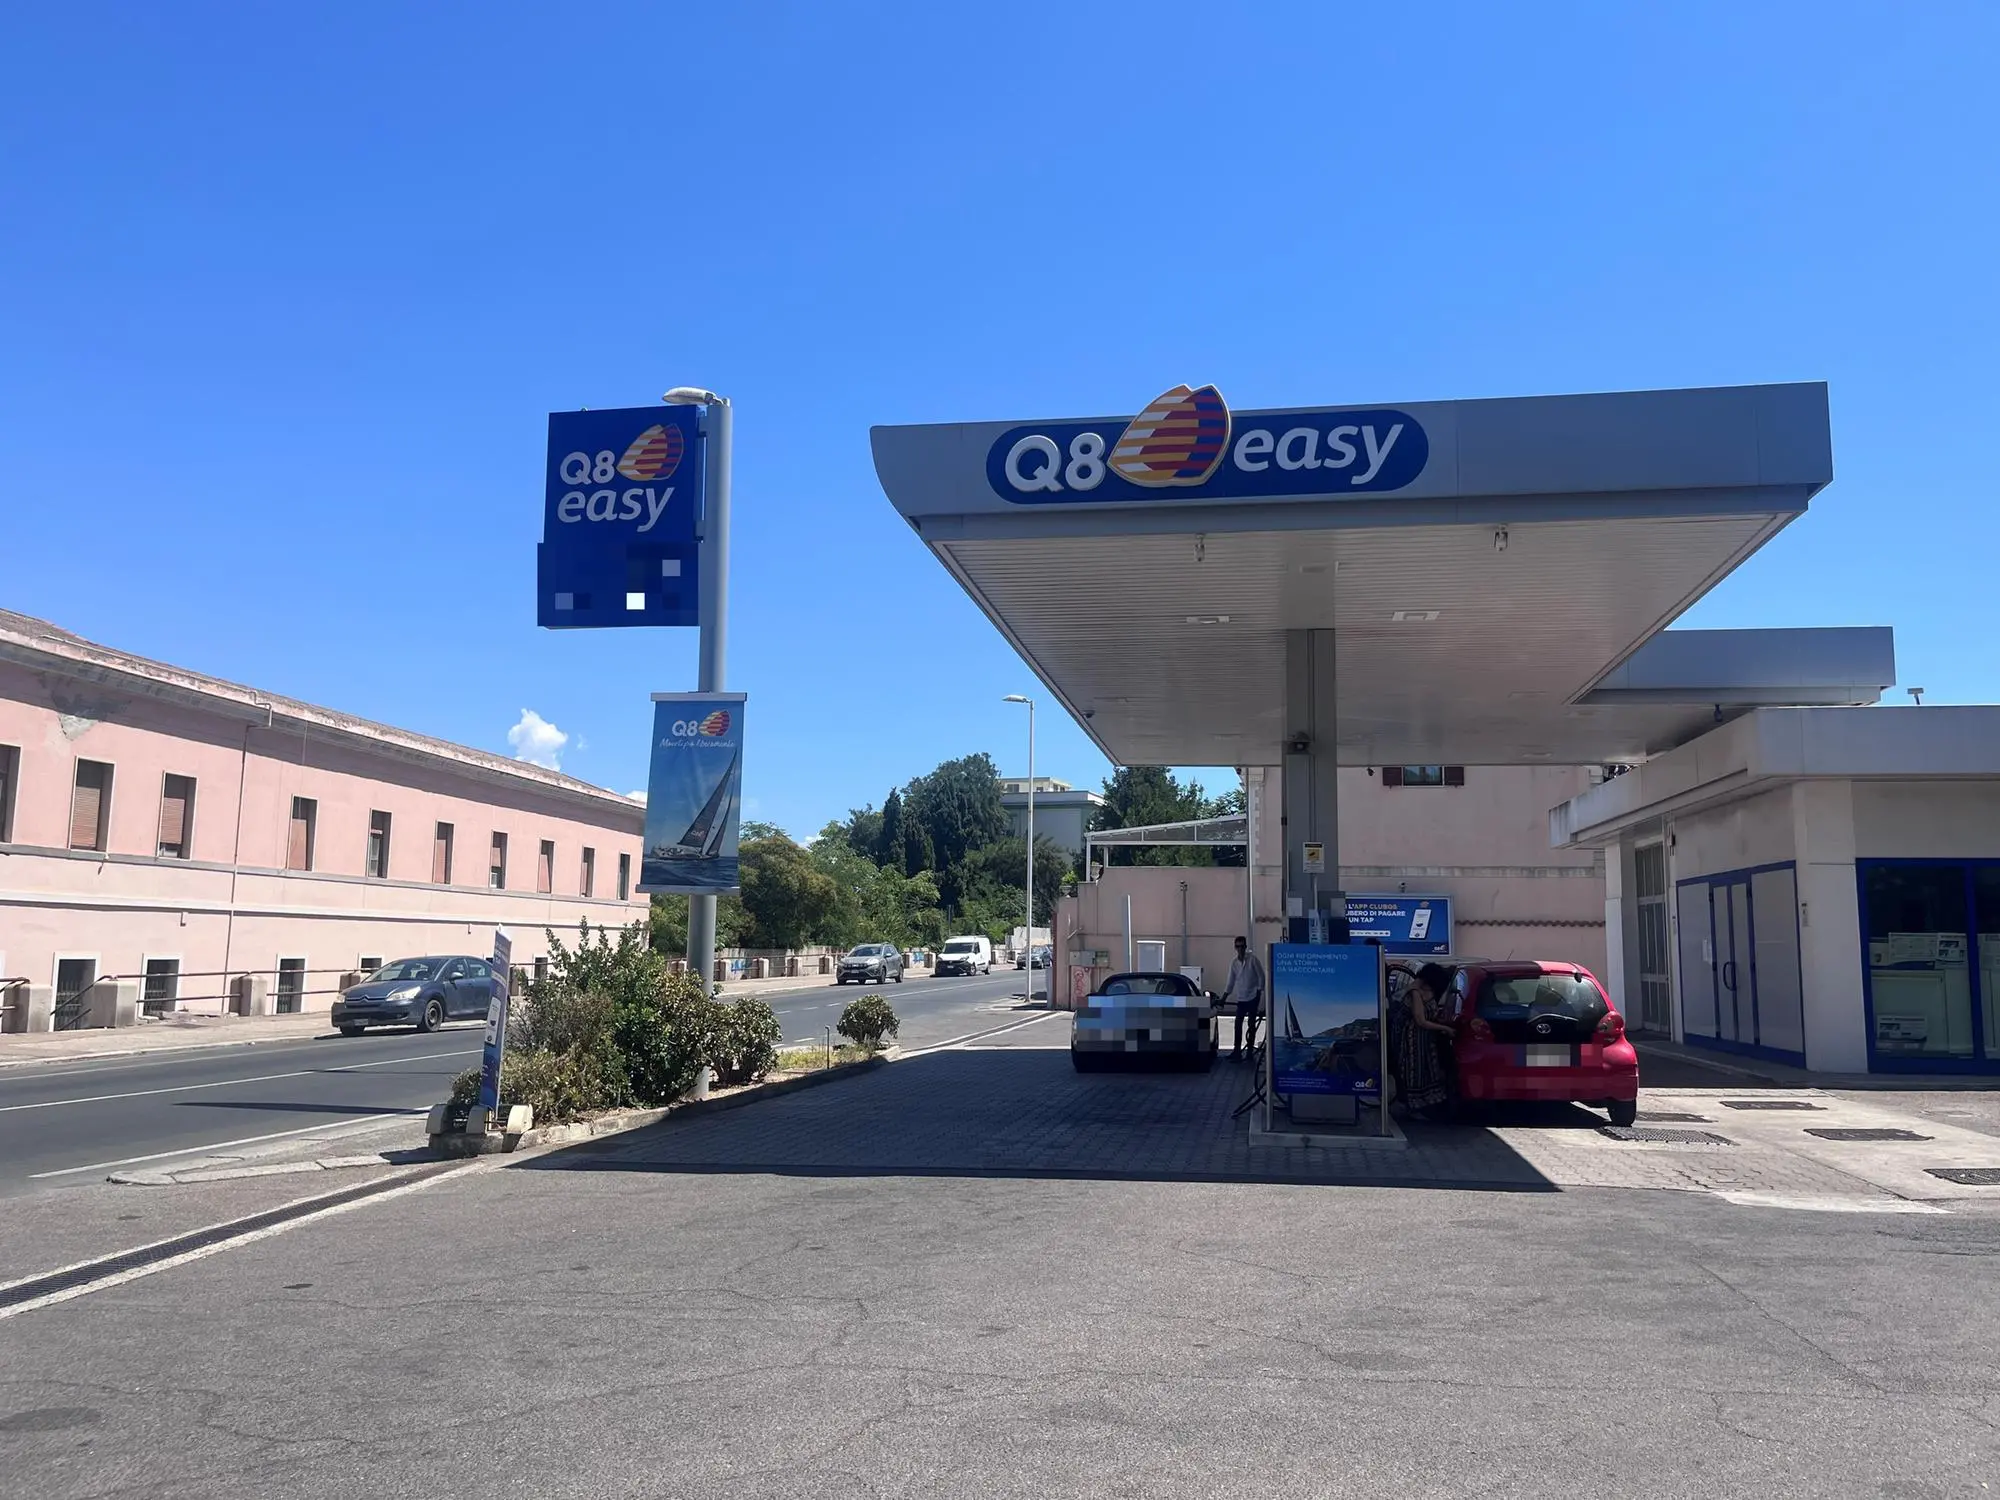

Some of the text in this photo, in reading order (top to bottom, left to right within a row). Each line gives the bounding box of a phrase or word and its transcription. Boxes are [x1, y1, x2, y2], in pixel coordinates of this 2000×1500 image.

[560, 450, 615, 485] Q8
[1005, 424, 1404, 492] Q8 easy
[557, 486, 675, 532] easy
[672, 720, 698, 737] Q8
